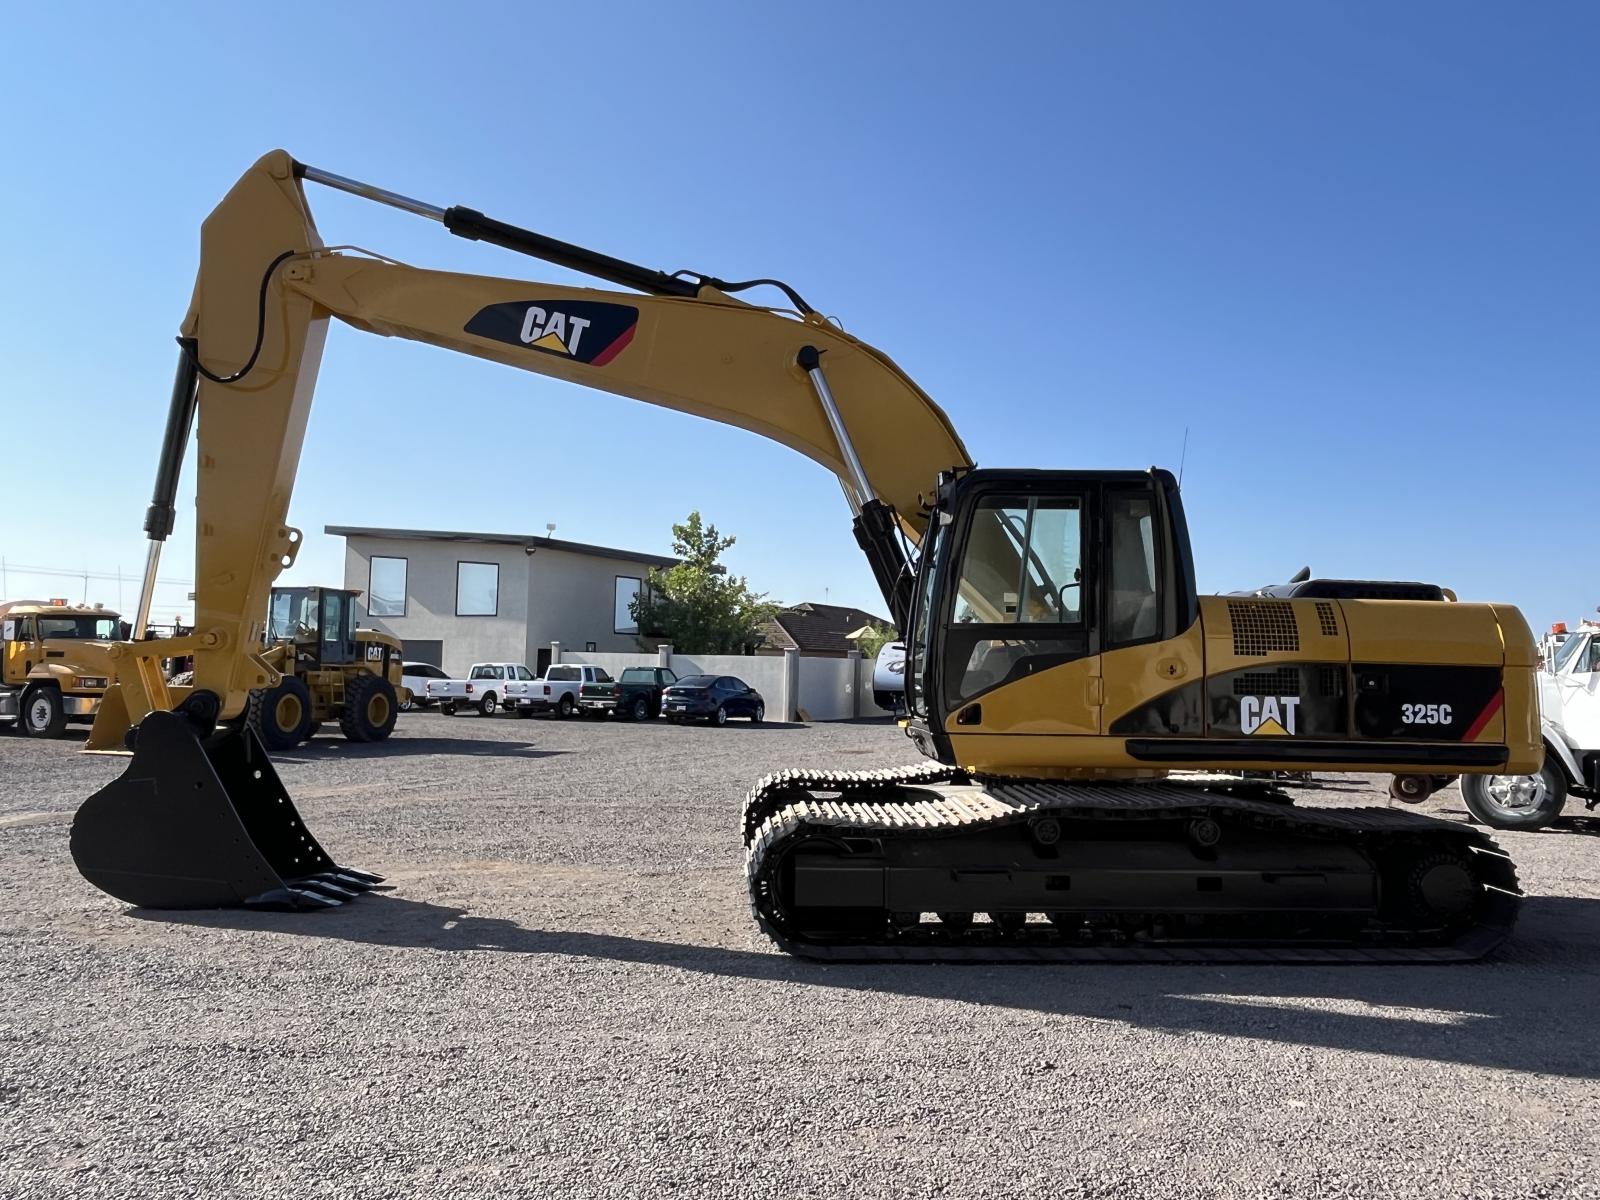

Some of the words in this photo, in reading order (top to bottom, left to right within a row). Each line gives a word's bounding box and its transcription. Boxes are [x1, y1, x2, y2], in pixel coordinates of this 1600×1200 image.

[520, 306, 591, 356] CAT
[367, 646, 383, 661] CAT
[1240, 695, 1300, 736] CAT
[1401, 703, 1453, 725] 325C
